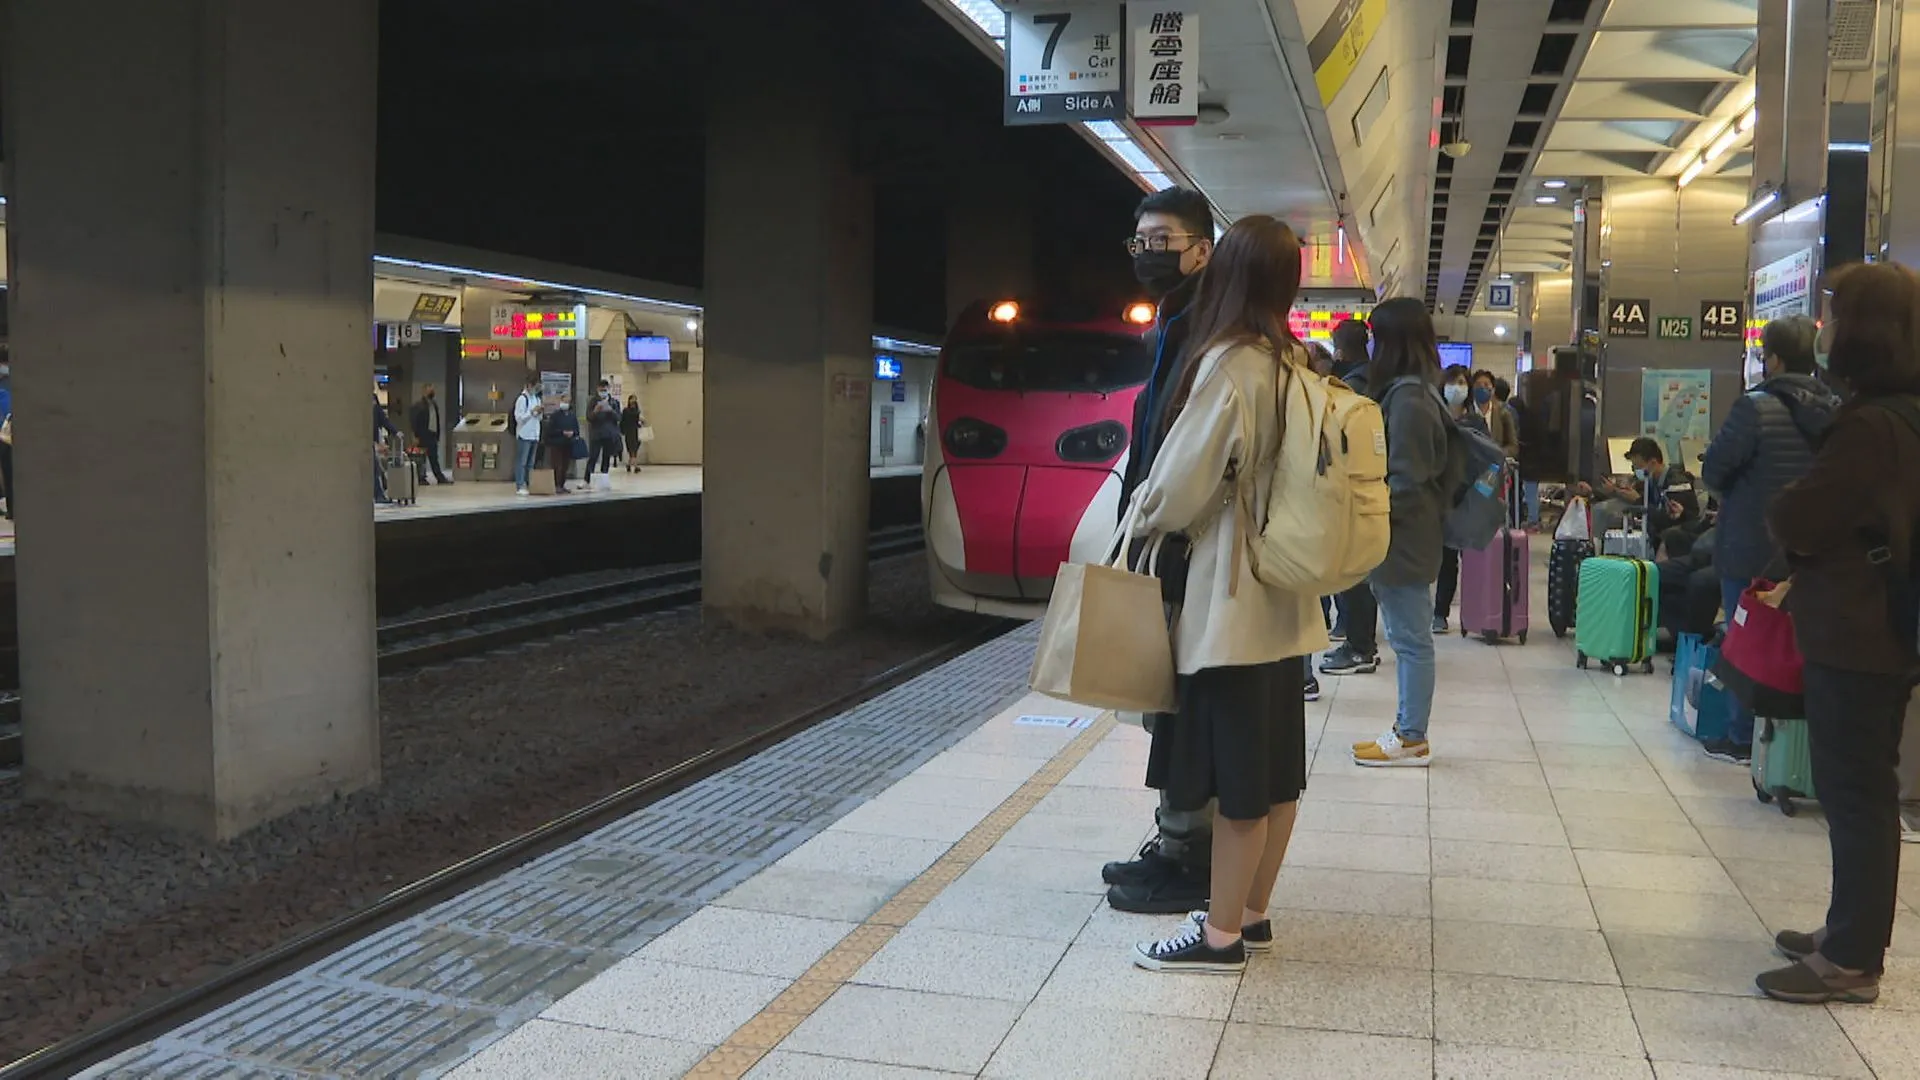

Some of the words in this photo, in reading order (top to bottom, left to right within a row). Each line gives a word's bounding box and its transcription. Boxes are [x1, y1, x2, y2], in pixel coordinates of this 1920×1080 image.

[1034, 13, 1071, 70] 7
[1093, 34, 1112, 52] 車
[1088, 55, 1117, 68] Car
[1065, 96, 1099, 110] Side
[1103, 95, 1114, 108] A
[1613, 304, 1645, 322] 4A
[1704, 305, 1737, 324] 4B
[405, 325, 412, 338] 6
[1660, 318, 1689, 337] M25
